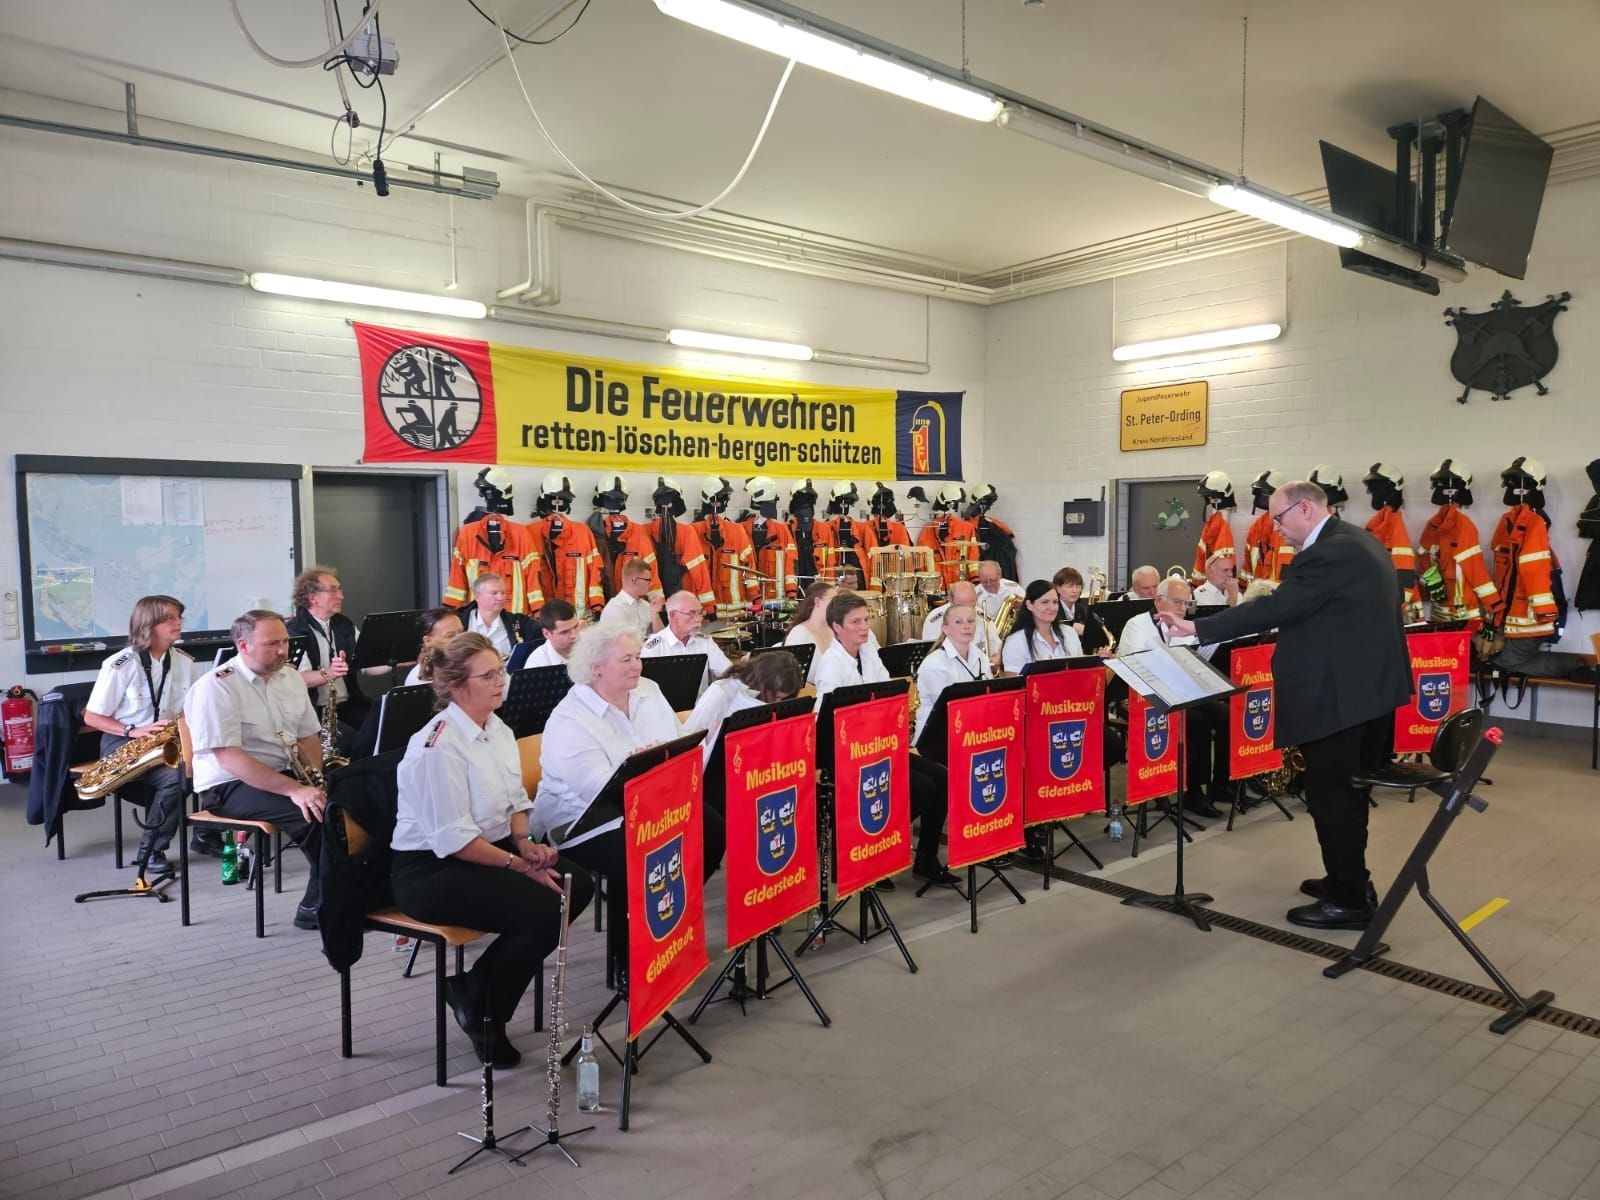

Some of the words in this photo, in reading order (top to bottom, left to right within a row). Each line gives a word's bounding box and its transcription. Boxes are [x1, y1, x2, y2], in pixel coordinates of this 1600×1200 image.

[566, 364, 629, 416] Die
[642, 374, 854, 433] Feuerwehren
[1136, 390, 1191, 403] Jugendfeuerwehr
[1126, 415, 1138, 427] St.
[1140, 409, 1201, 426] Peter-Ording
[522, 421, 881, 466] retten-löschen-bergen-schützen
[1132, 437, 1149, 446] Kreis
[1150, 434, 1193, 445] Nordfriesland
[1411, 656, 1458, 670] Musikzug
[1041, 699, 1096, 716] Musikzug
[849, 732, 899, 761] Musikzug
[962, 725, 1016, 748] Musikzug
[1238, 740, 1274, 758] Eidersted
[746, 756, 807, 792] Musikzug
[1138, 759, 1177, 781] Eiderstedt
[1038, 778, 1094, 799] Eiderstedt
[636, 799, 693, 847] Musikzug
[963, 812, 1015, 840] Eiderstedt
[850, 829, 902, 863] Eiderstedt
[743, 866, 807, 907] Eiderstedt
[645, 925, 694, 985] Eiderstedt
